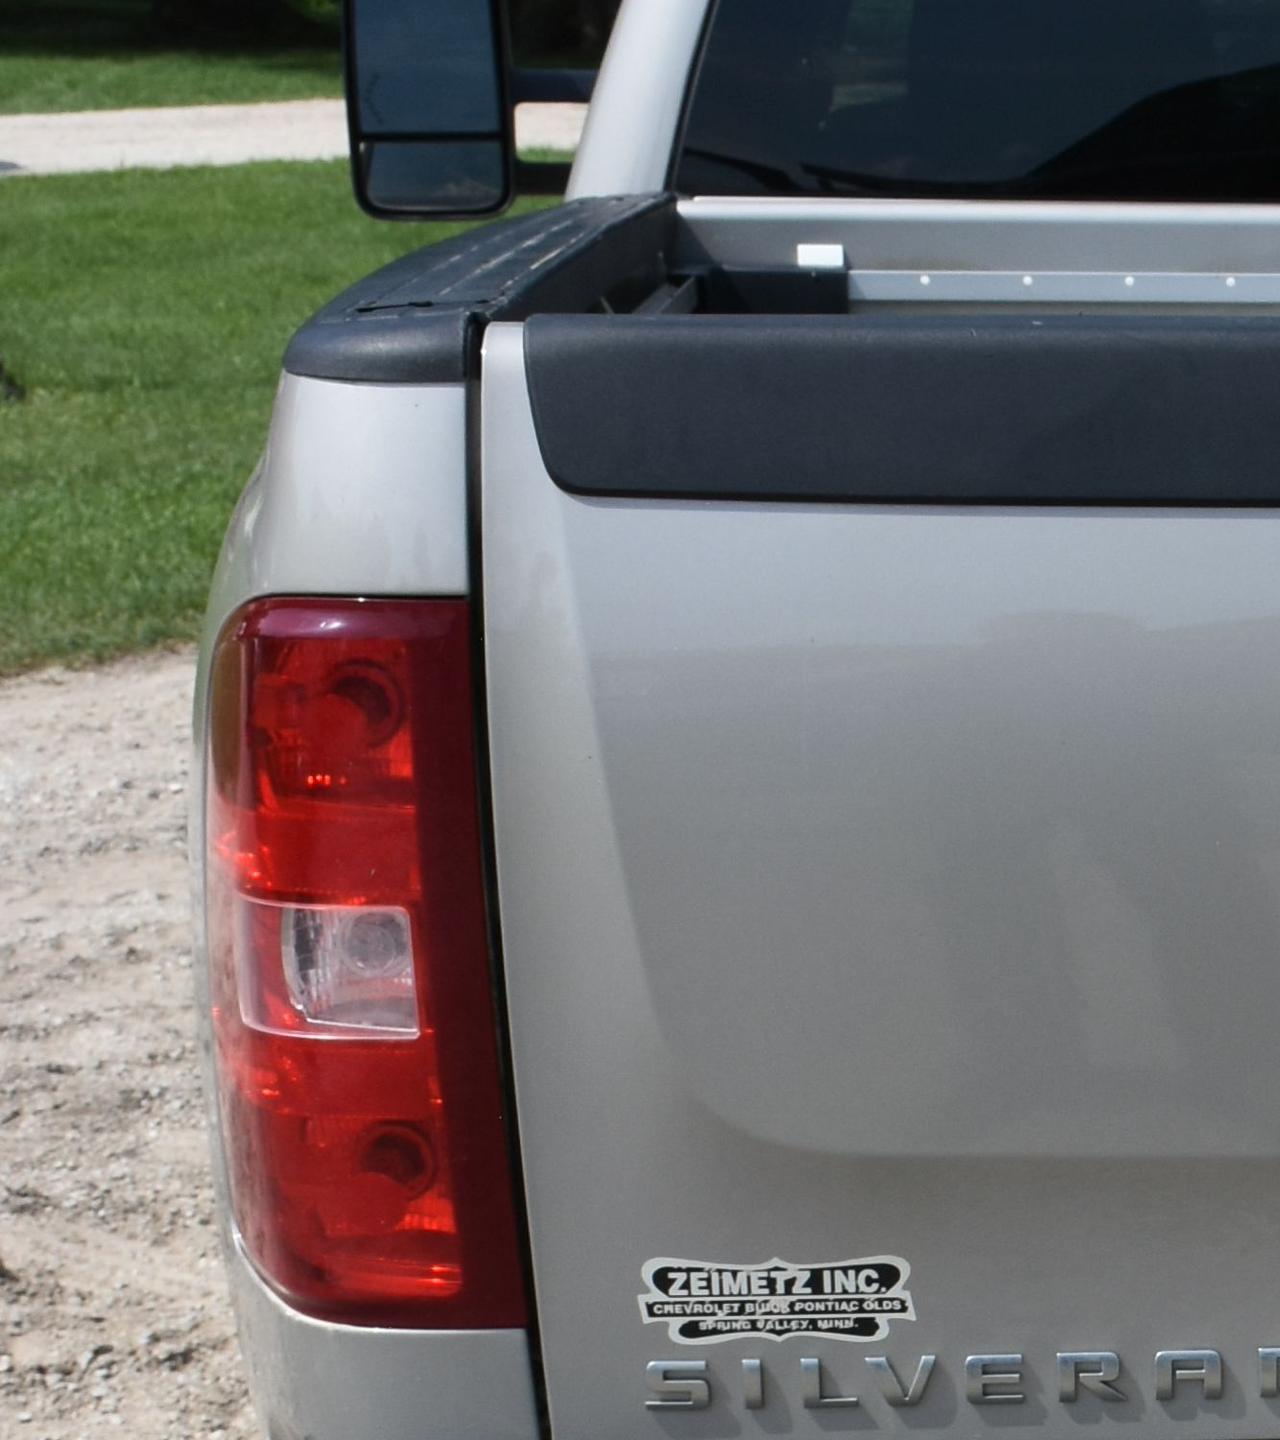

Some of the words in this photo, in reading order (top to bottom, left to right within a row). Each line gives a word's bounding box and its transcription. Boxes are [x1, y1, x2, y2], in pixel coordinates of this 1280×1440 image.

[667, 1269, 813, 1297] ZEIMETZ
[822, 1268, 888, 1294] INC.
[653, 1302, 741, 1315] CHEVROLET
[794, 1301, 860, 1312] PONTIAC
[862, 1299, 902, 1311] OLDS
[698, 1319, 752, 1331] SPRING
